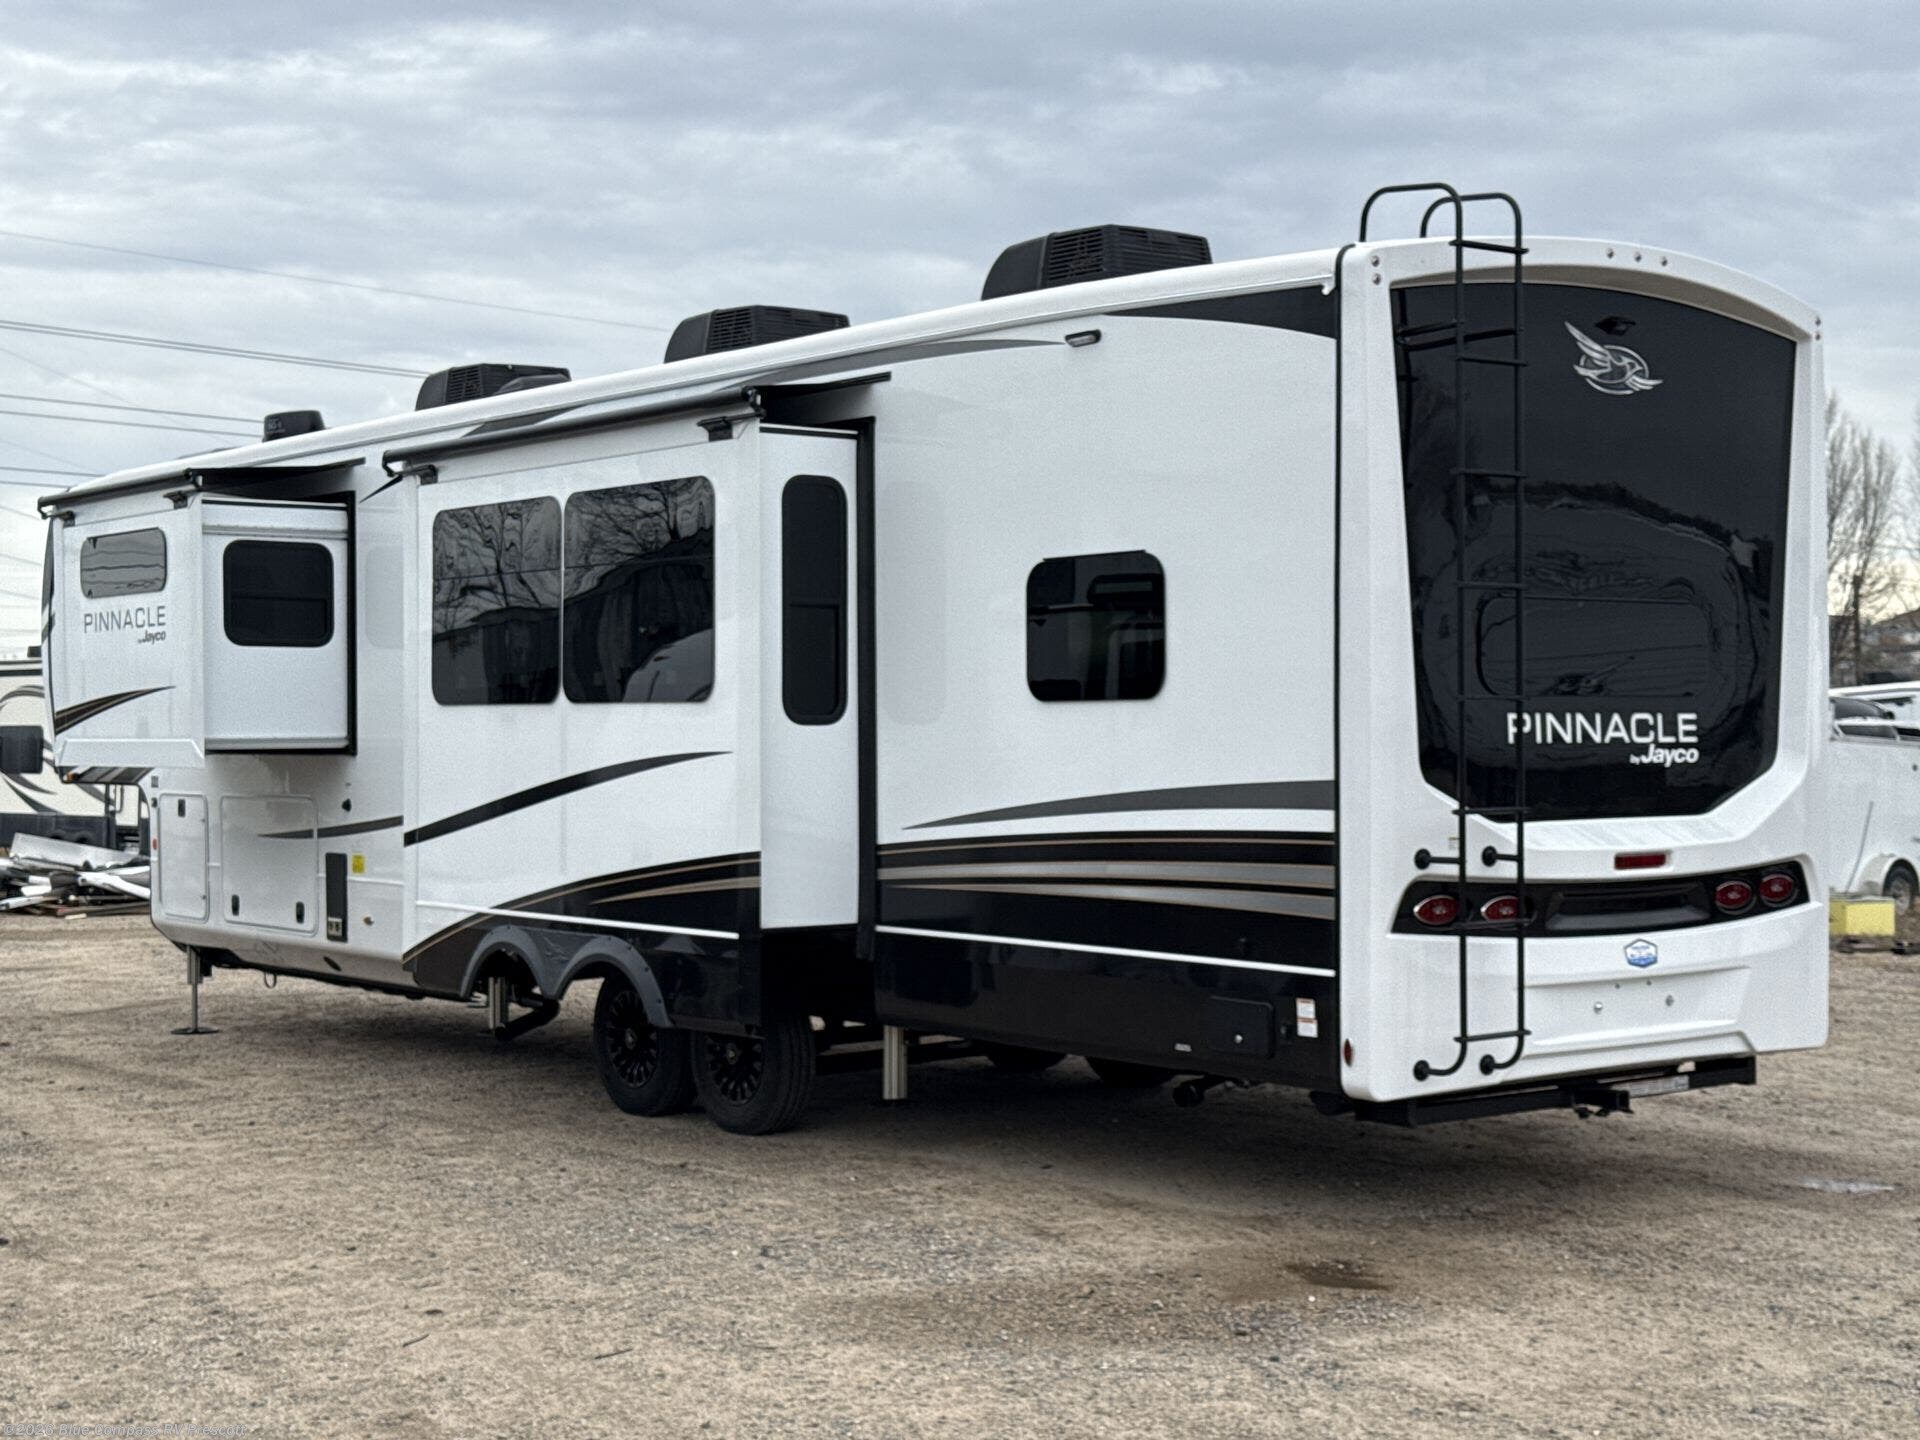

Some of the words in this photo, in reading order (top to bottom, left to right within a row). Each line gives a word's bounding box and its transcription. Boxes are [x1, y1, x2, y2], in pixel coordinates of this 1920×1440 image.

[83, 605, 166, 634] PINNACLE
[142, 630, 166, 645] Jayco
[1506, 712, 1699, 745] PINNACLE
[1640, 743, 1699, 768] Jayco
